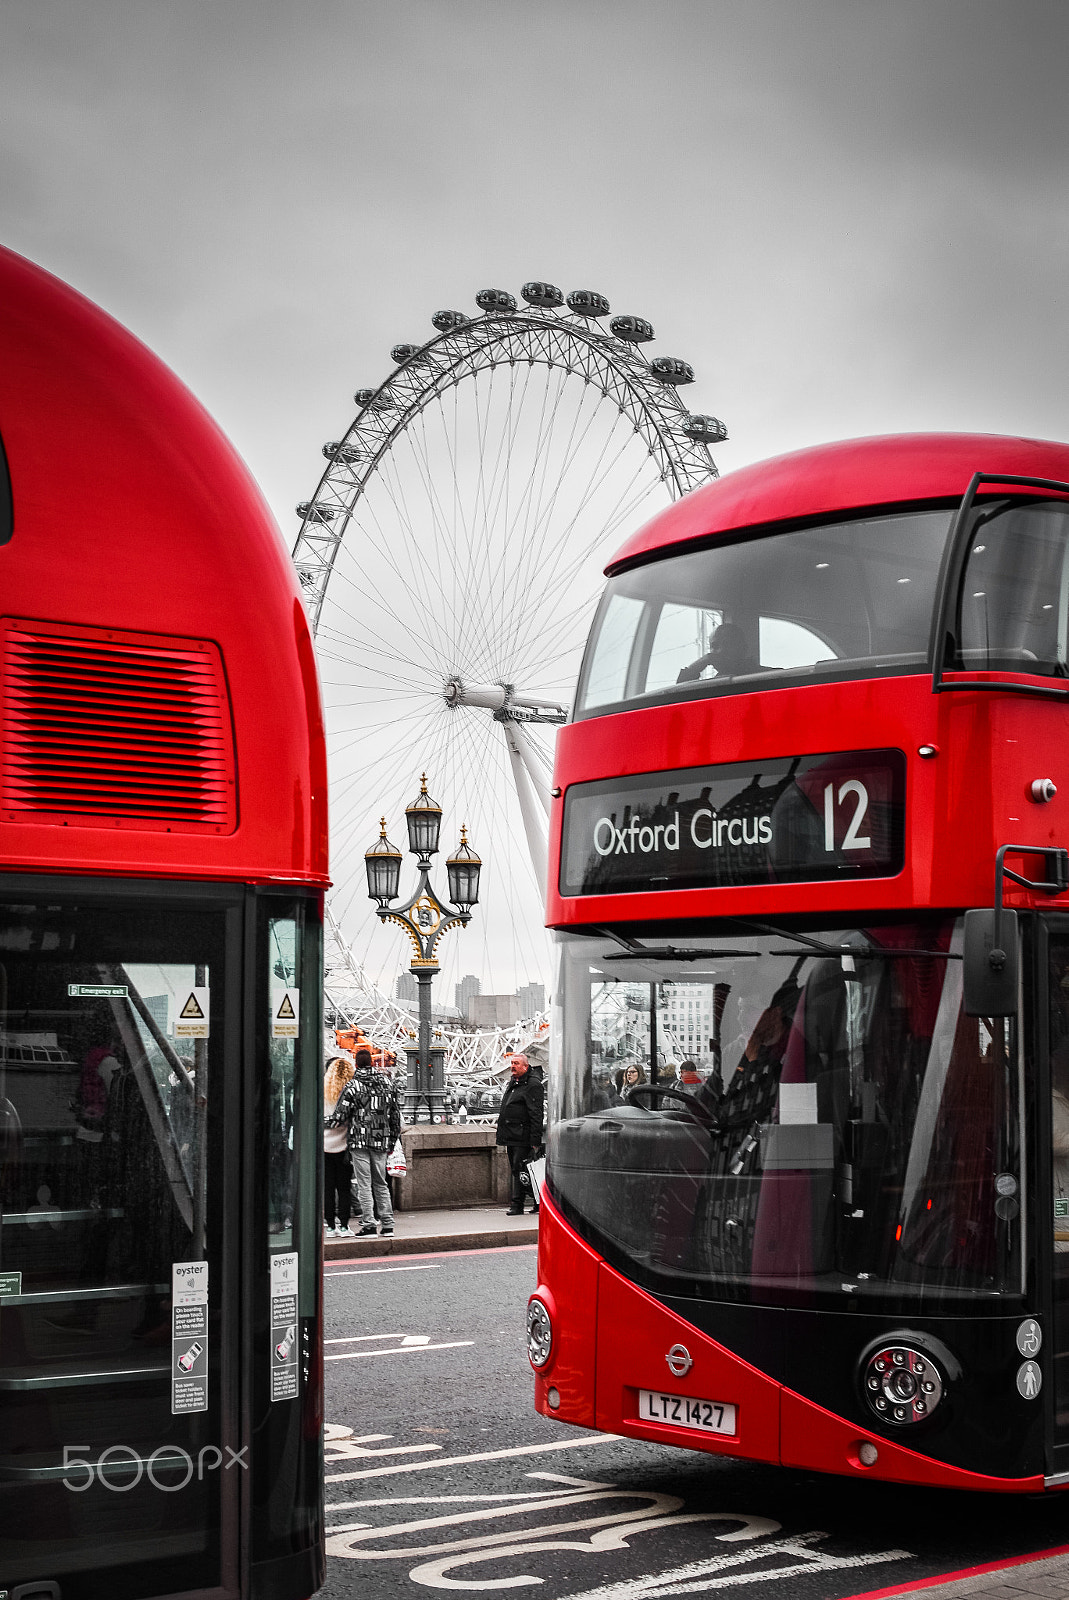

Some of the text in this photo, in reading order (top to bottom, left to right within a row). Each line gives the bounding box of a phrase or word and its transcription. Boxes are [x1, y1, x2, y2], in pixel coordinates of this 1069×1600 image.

[824, 779, 872, 852] 12
[593, 808, 772, 856] Oxford Circus
[81, 987, 111, 995] Emergency
[274, 1257, 295, 1268] oyster
[176, 1266, 205, 1277] oyster
